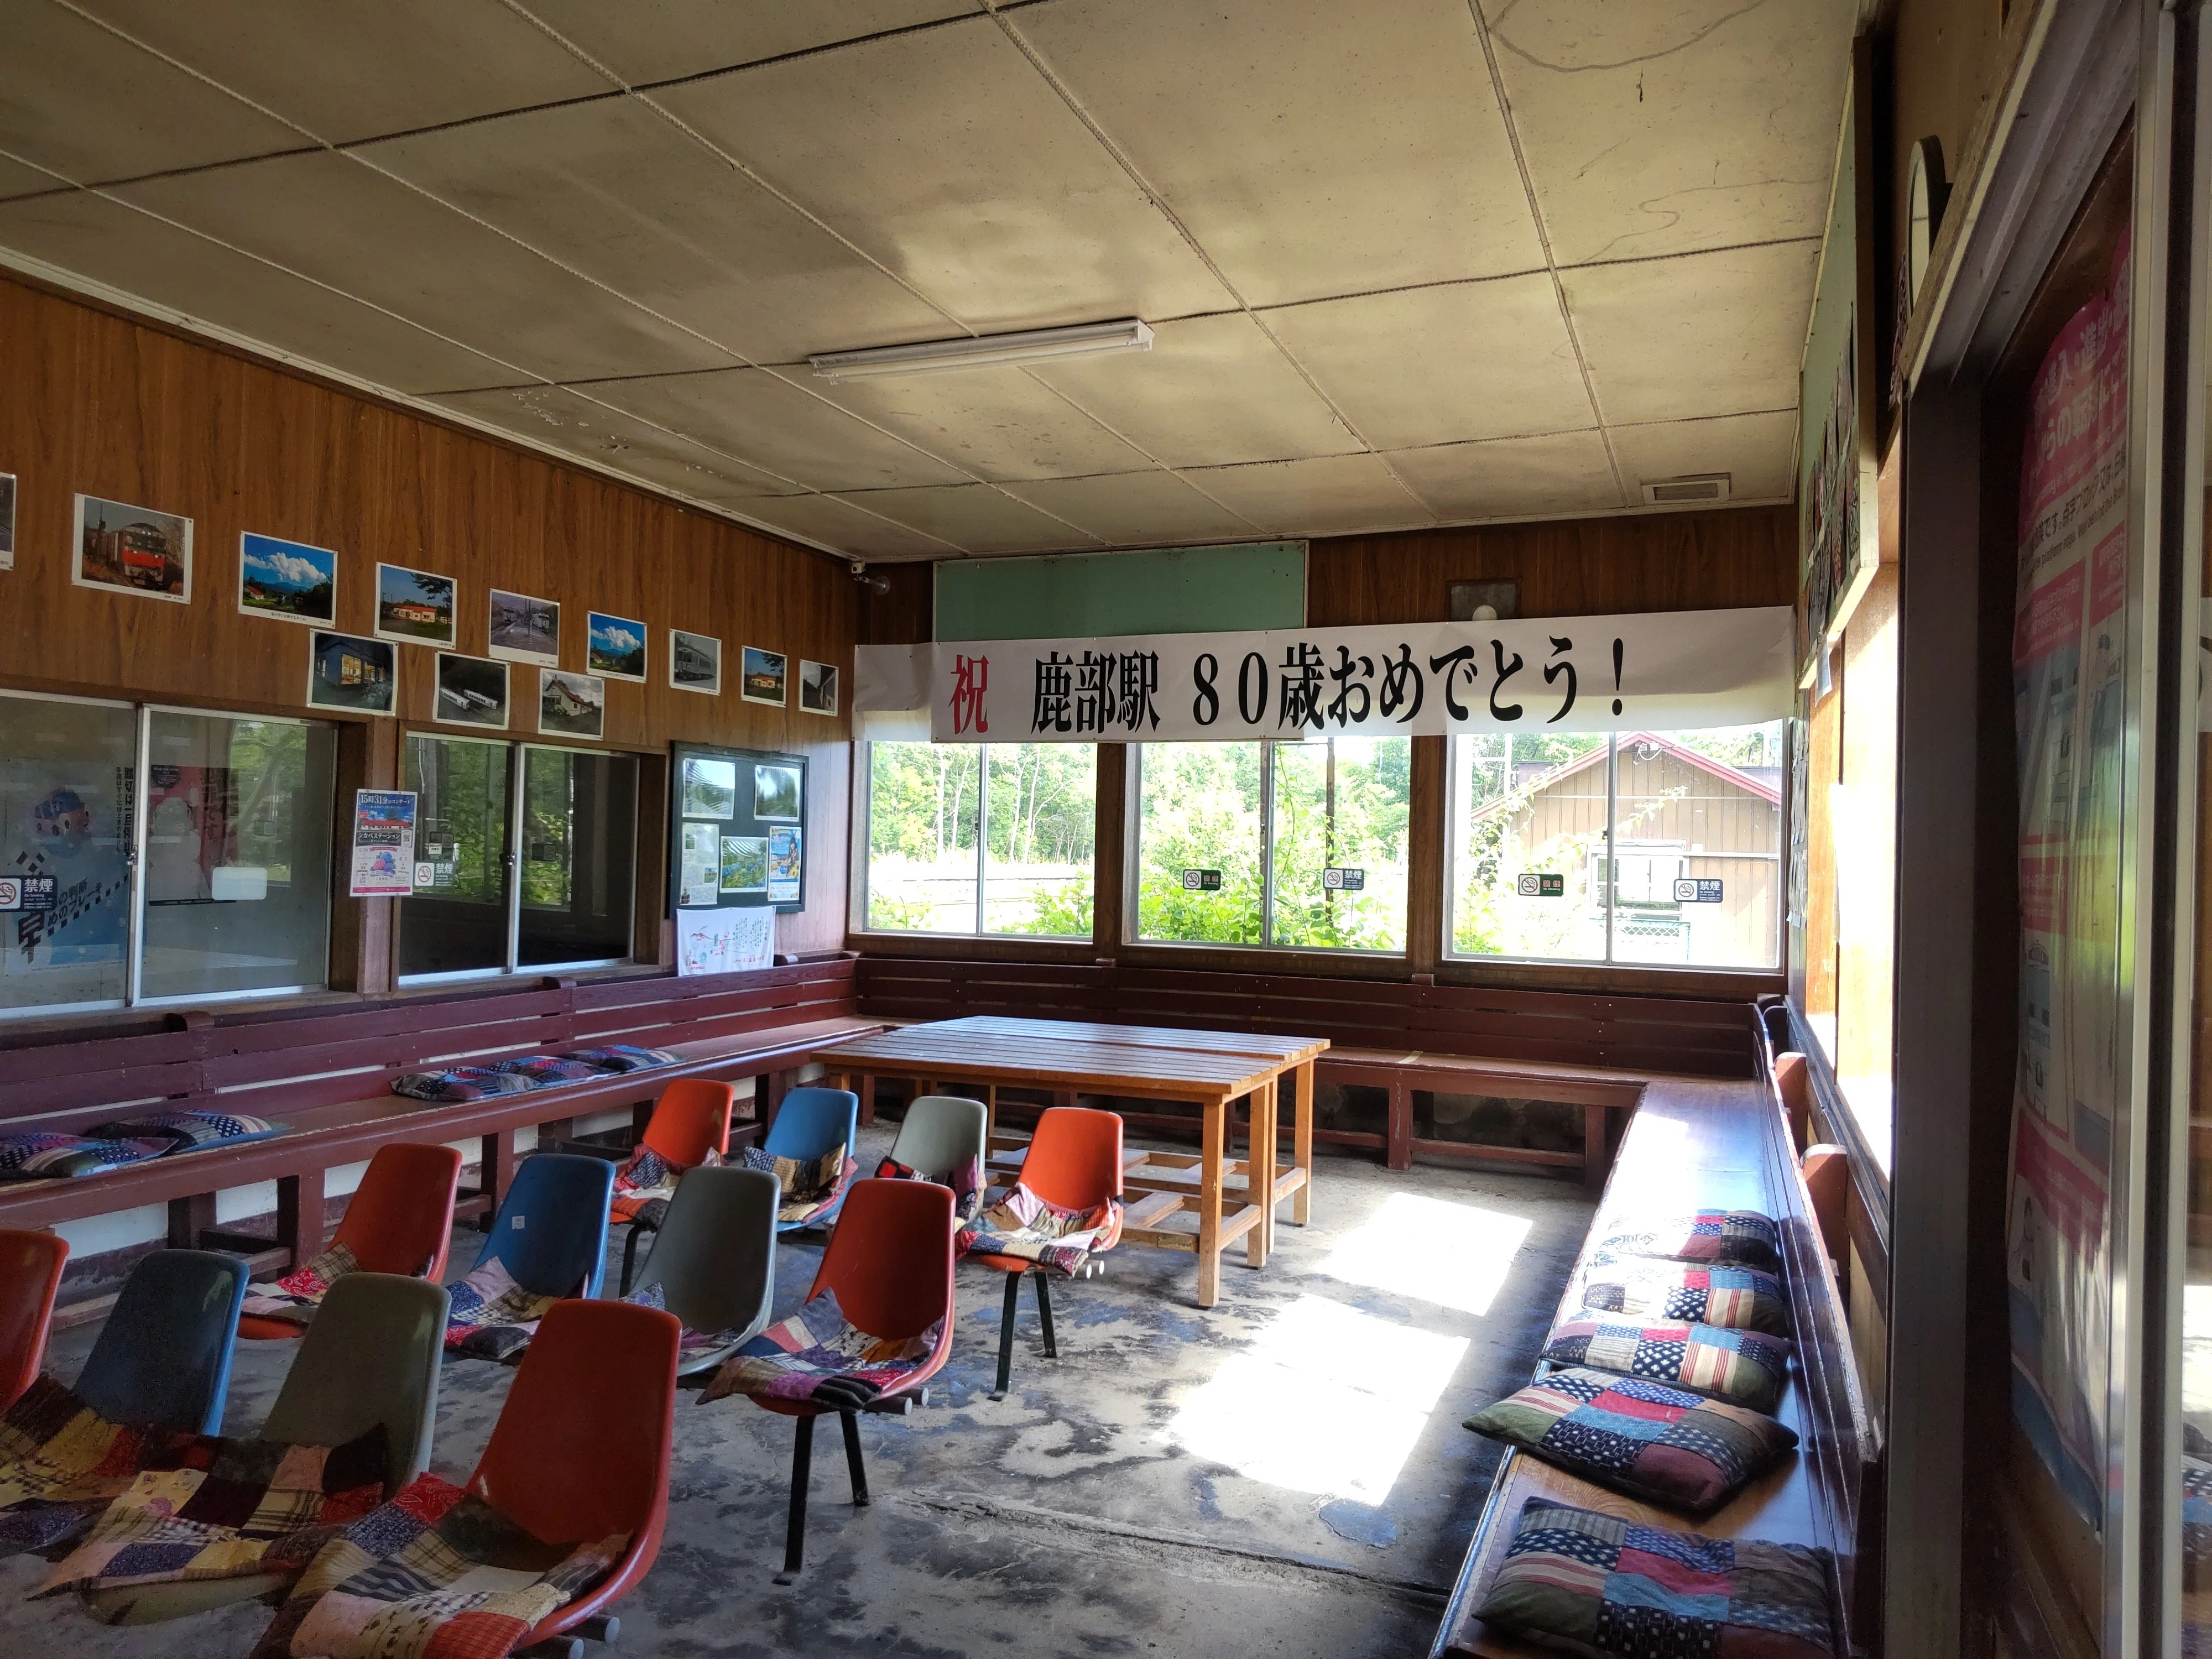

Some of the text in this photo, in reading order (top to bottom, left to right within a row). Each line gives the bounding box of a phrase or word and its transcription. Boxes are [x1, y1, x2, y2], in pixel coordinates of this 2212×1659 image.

[948, 654, 989, 733] 祝
[1031, 650, 1161, 734] 鹿部駅
[436, 863, 454, 874] 禁煙
[1344, 870, 1362, 879] 禁煙
[24, 878, 54, 893] 禁煙
[1699, 880, 1720, 890] 禁煙
